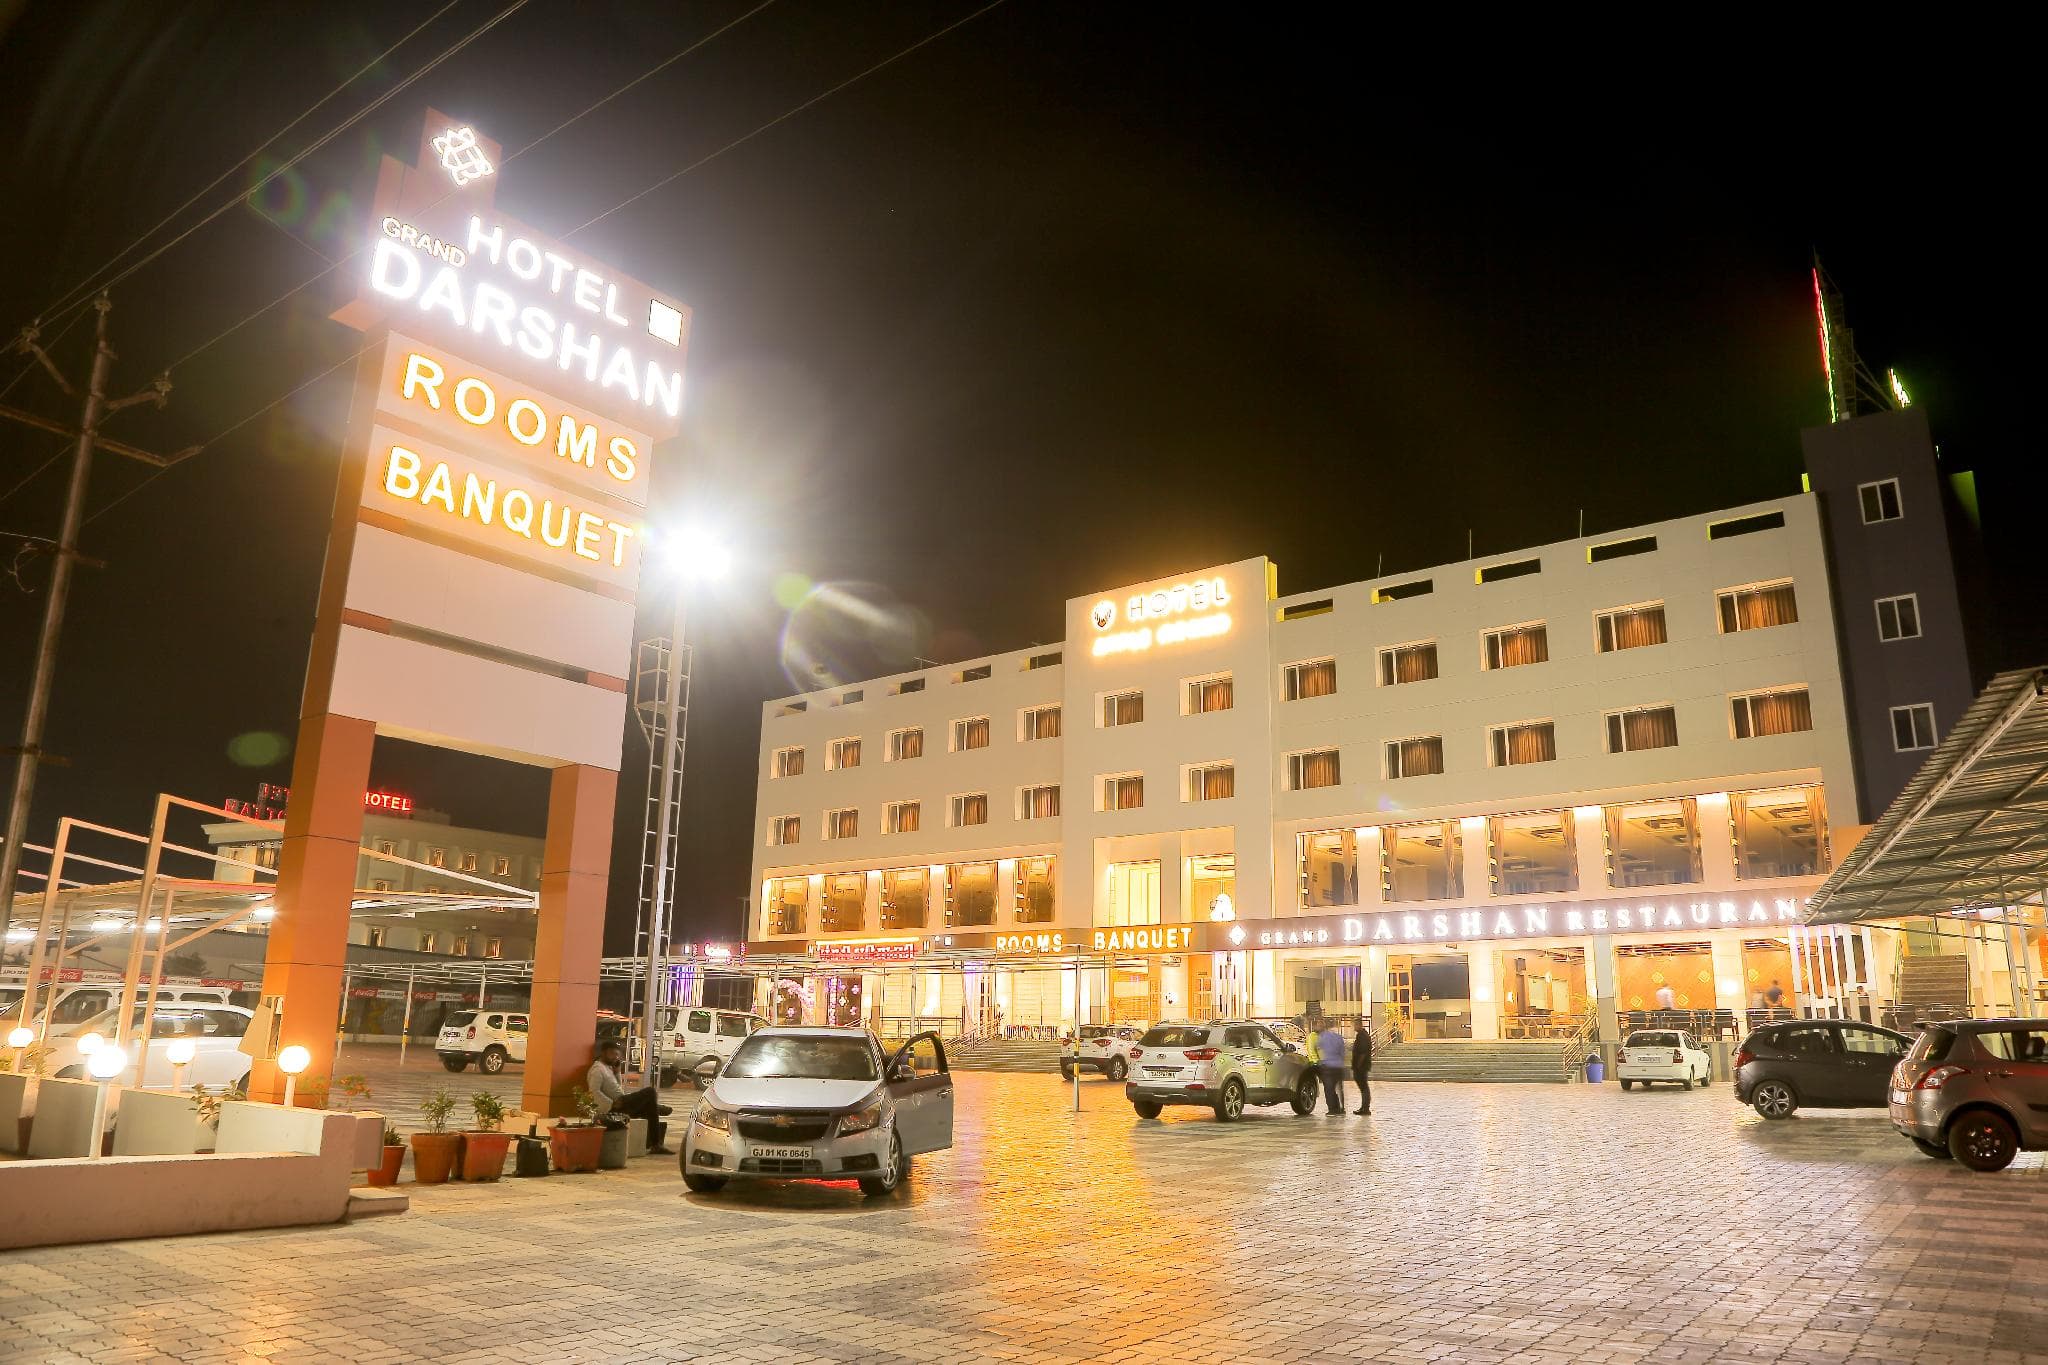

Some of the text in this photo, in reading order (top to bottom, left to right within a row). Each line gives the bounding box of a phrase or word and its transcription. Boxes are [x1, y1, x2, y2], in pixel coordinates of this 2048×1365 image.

[382, 217, 466, 267] GRAND
[467, 214, 629, 327] HOTEL
[371, 237, 683, 416] DARSHAN
[402, 353, 637, 481] ROOMS
[385, 446, 635, 567] BANQUET
[1127, 578, 1229, 620] HOTEL
[996, 933, 1063, 953] ROOMS
[1094, 927, 1192, 951] BANQUET
[1261, 898, 1812, 946] GRAND DARSHAN RESTAURAN
[753, 1148, 764, 1157] GJ
[776, 1149, 788, 1157] KG
